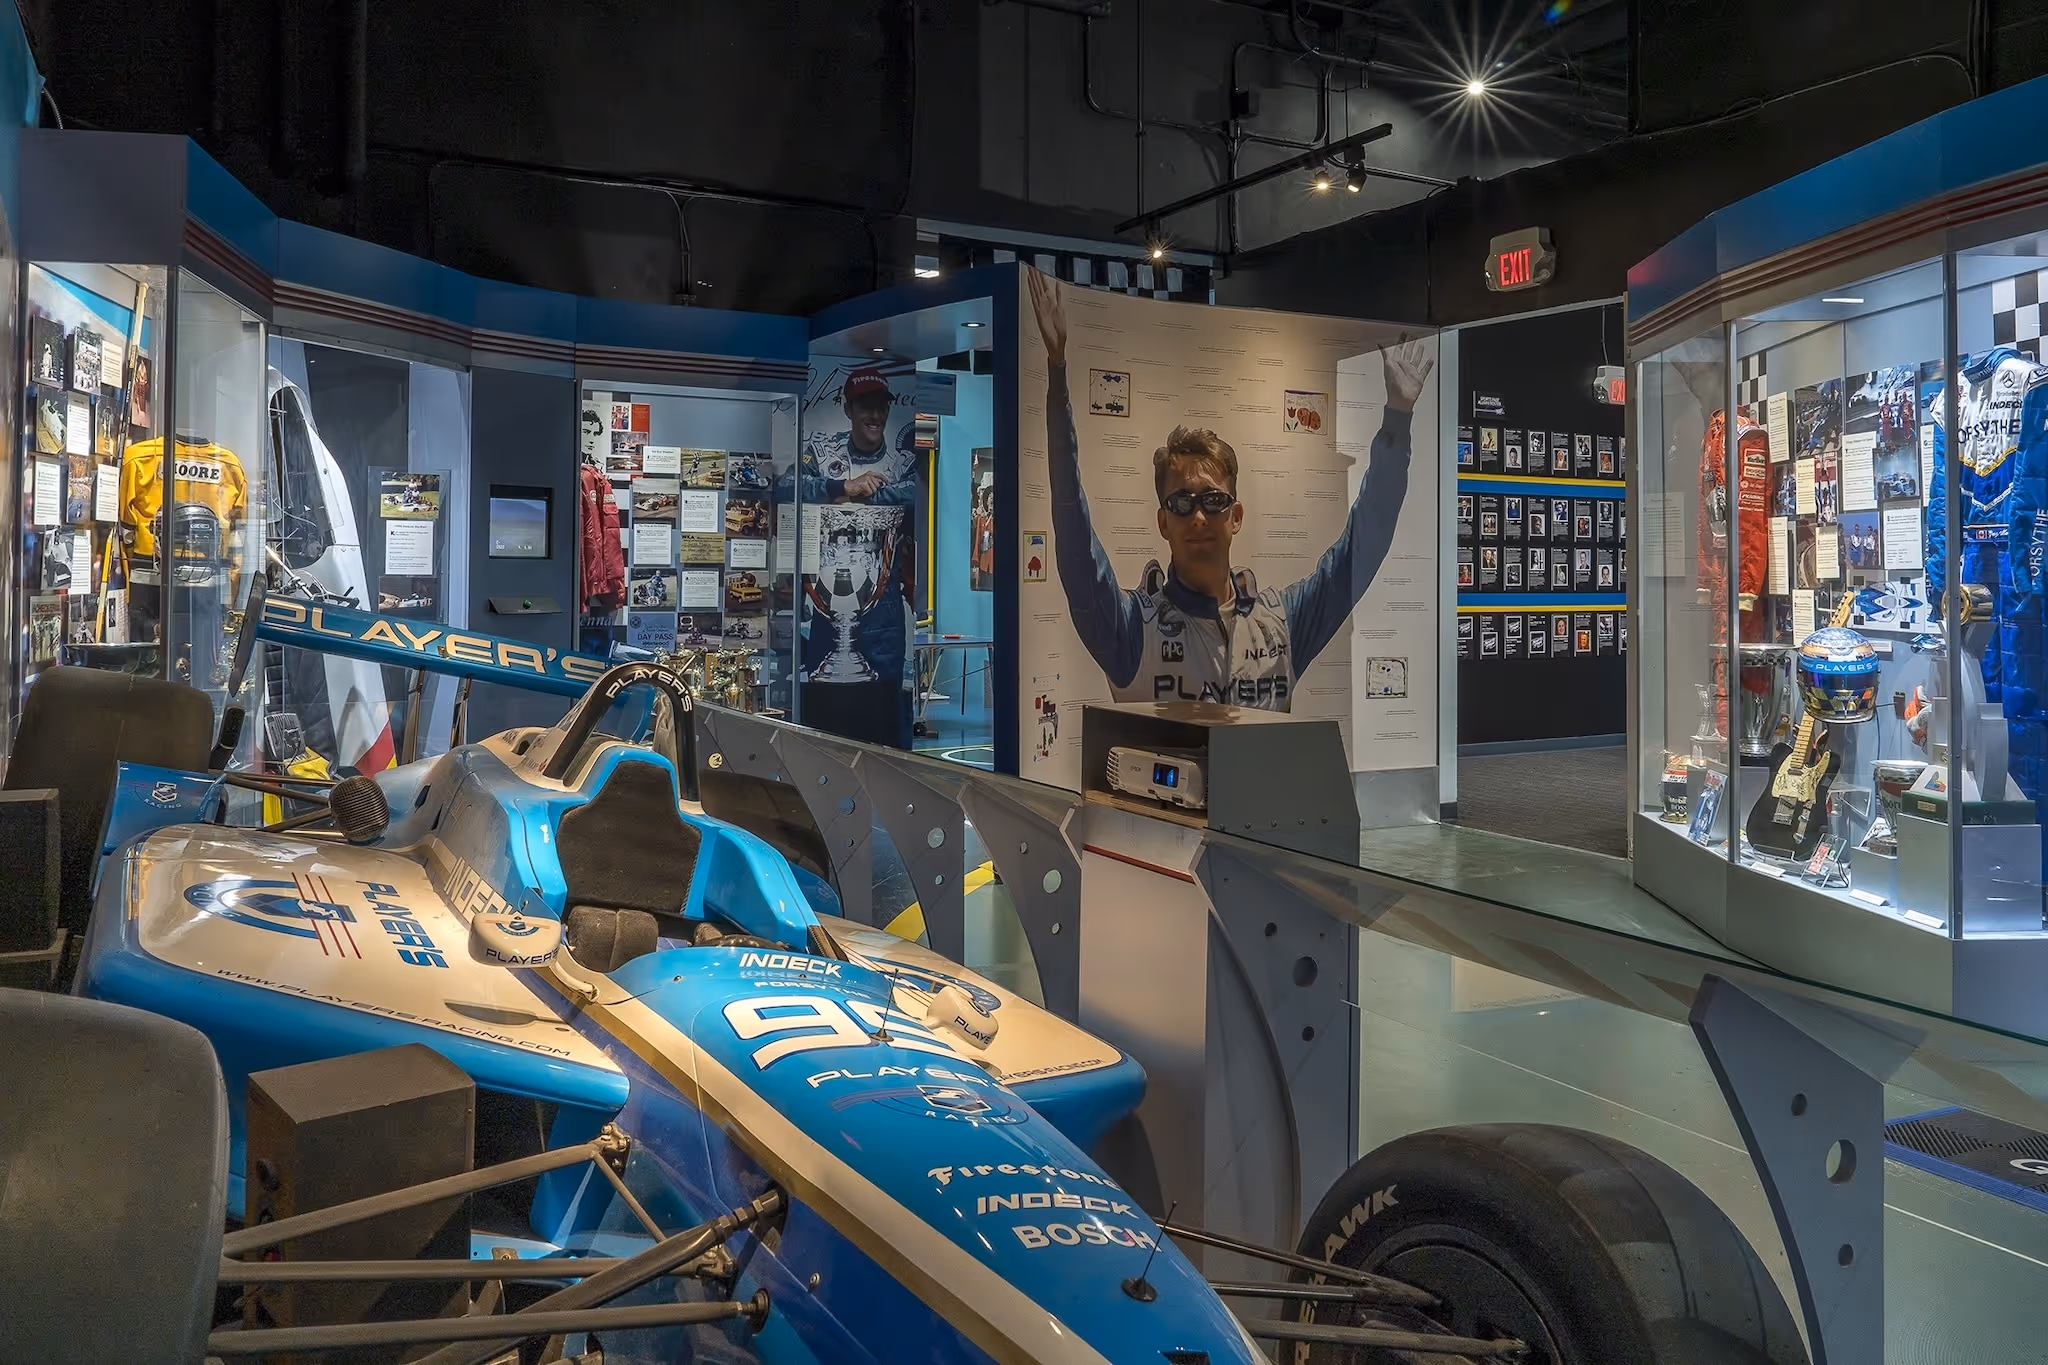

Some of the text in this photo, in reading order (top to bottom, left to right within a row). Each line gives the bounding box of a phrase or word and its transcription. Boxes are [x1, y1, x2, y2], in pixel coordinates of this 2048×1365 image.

[1501, 248, 1530, 286] EXIT
[1611, 379, 1625, 401] EXI
[1990, 400, 2022, 410] INDEC
[174, 463, 220, 481] OORE
[579, 615, 613, 627] enna
[260, 597, 607, 682] PLAYER'S
[637, 633, 674, 641] DAY PASS
[1162, 641, 1184, 660] PPG
[1815, 662, 1873, 672] PLAYER'S
[605, 668, 693, 713] PLAYER'S
[143, 797, 182, 809] RACING
[355, 879, 450, 969] PLAYER'S
[738, 952, 842, 979] INDECK
[753, 981, 872, 1000] FORSYTHE
[954, 1015, 991, 1046] PLAYE
[925, 1109, 1018, 1124] RACING
[927, 1163, 1123, 1193] Firestone
[976, 1193, 1140, 1220] INDECK
[1012, 1222, 1164, 1254] BOSCH
